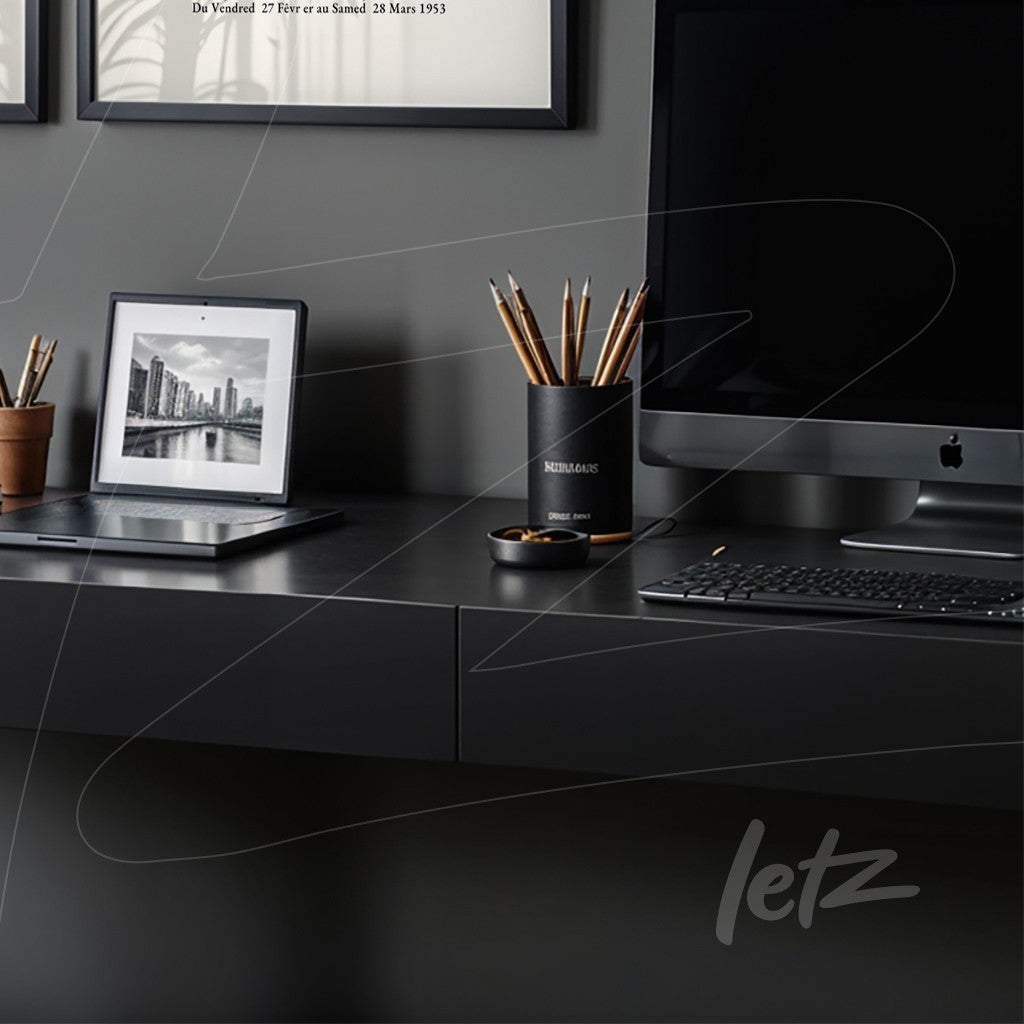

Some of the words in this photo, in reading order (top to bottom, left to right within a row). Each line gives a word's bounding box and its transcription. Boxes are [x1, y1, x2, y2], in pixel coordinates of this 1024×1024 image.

[192, 2, 208, 14] Du
[211, 1, 256, 14] Vendred
[261, 2, 275, 14] 27
[316, 5, 329, 14] au
[331, 2, 366, 14] Samed
[372, 2, 386, 14] 28
[389, 2, 416, 14] Mars
[420, 3, 446, 15] 1953
